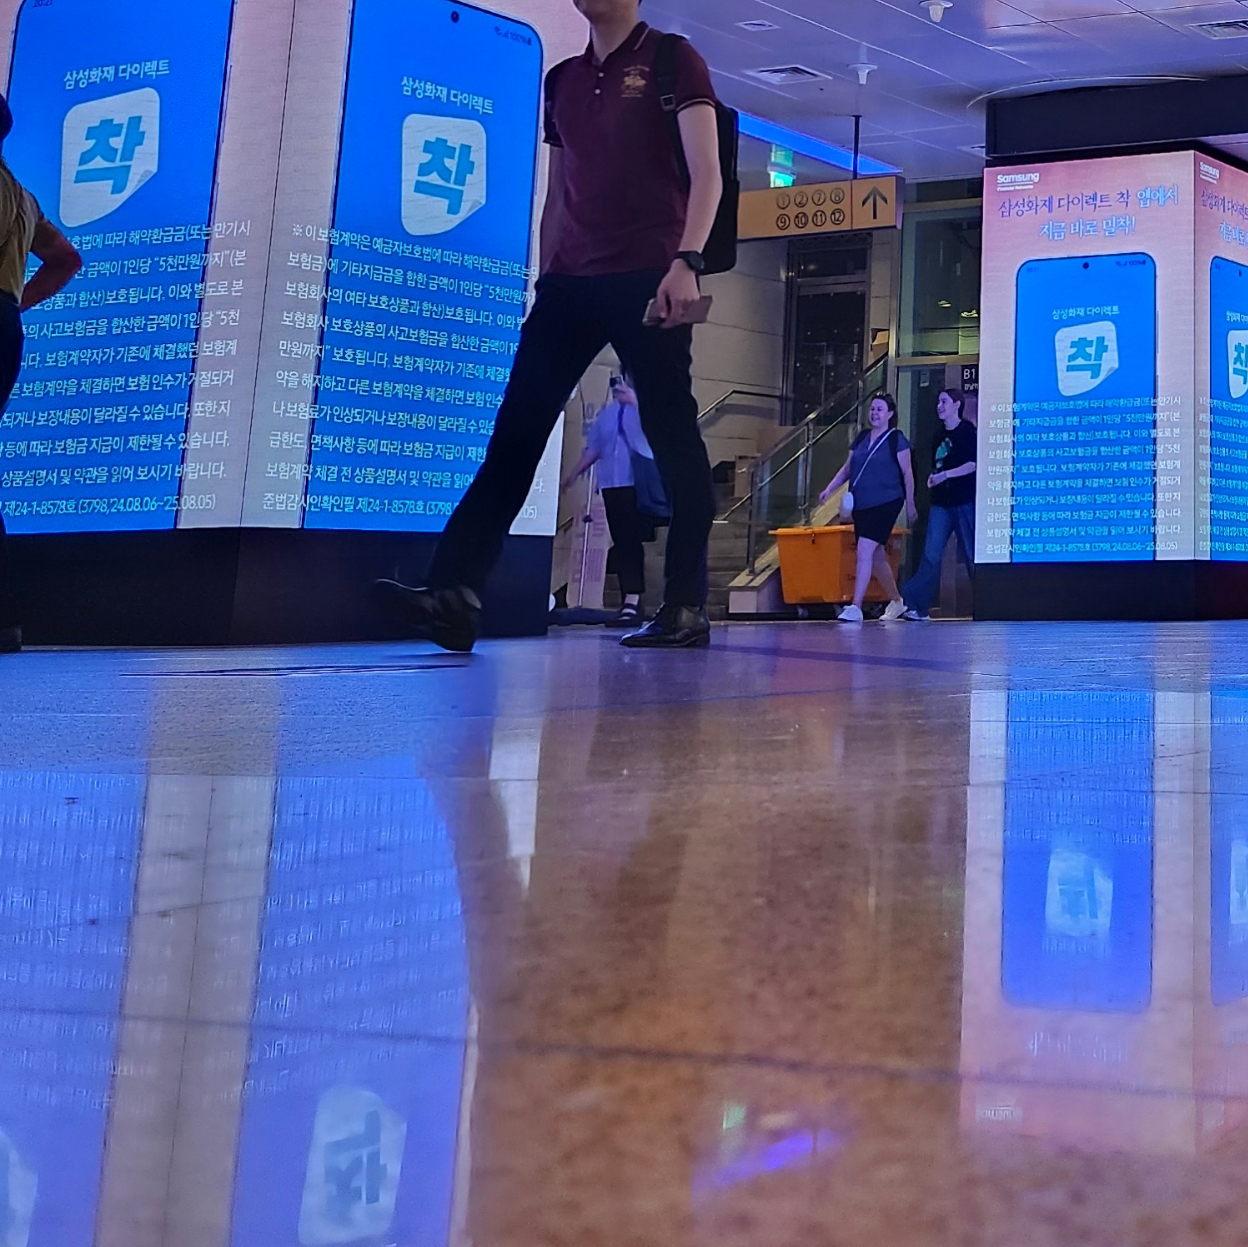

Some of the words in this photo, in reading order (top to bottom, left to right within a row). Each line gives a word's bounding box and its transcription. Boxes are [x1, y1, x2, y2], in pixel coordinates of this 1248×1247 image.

[63, 65, 115, 90] 삼성화재
[118, 59, 170, 81] 다이렉트
[401, 76, 447, 103] 삼성화재
[450, 89, 494, 115] 다이렉트
[73, 115, 146, 195] 착
[413, 137, 475, 216] 착
[997, 173, 1039, 184] Samsung
[998, 195, 1054, 218] 삼성화재
[1057, 191, 1112, 212] 다이렉트
[1116, 189, 1131, 208] 착
[1136, 185, 1179, 208] 앱에서
[1039, 221, 1067, 240] 지금
[1070, 218, 1098, 237] 바로
[1102, 214, 1136, 236] 밀착!
[1052, 307, 1085, 320] 삼성화재
[1086, 305, 1120, 316] 다이렉트
[1066, 336, 1109, 379] 착
[963, 368, 976, 380] B1
